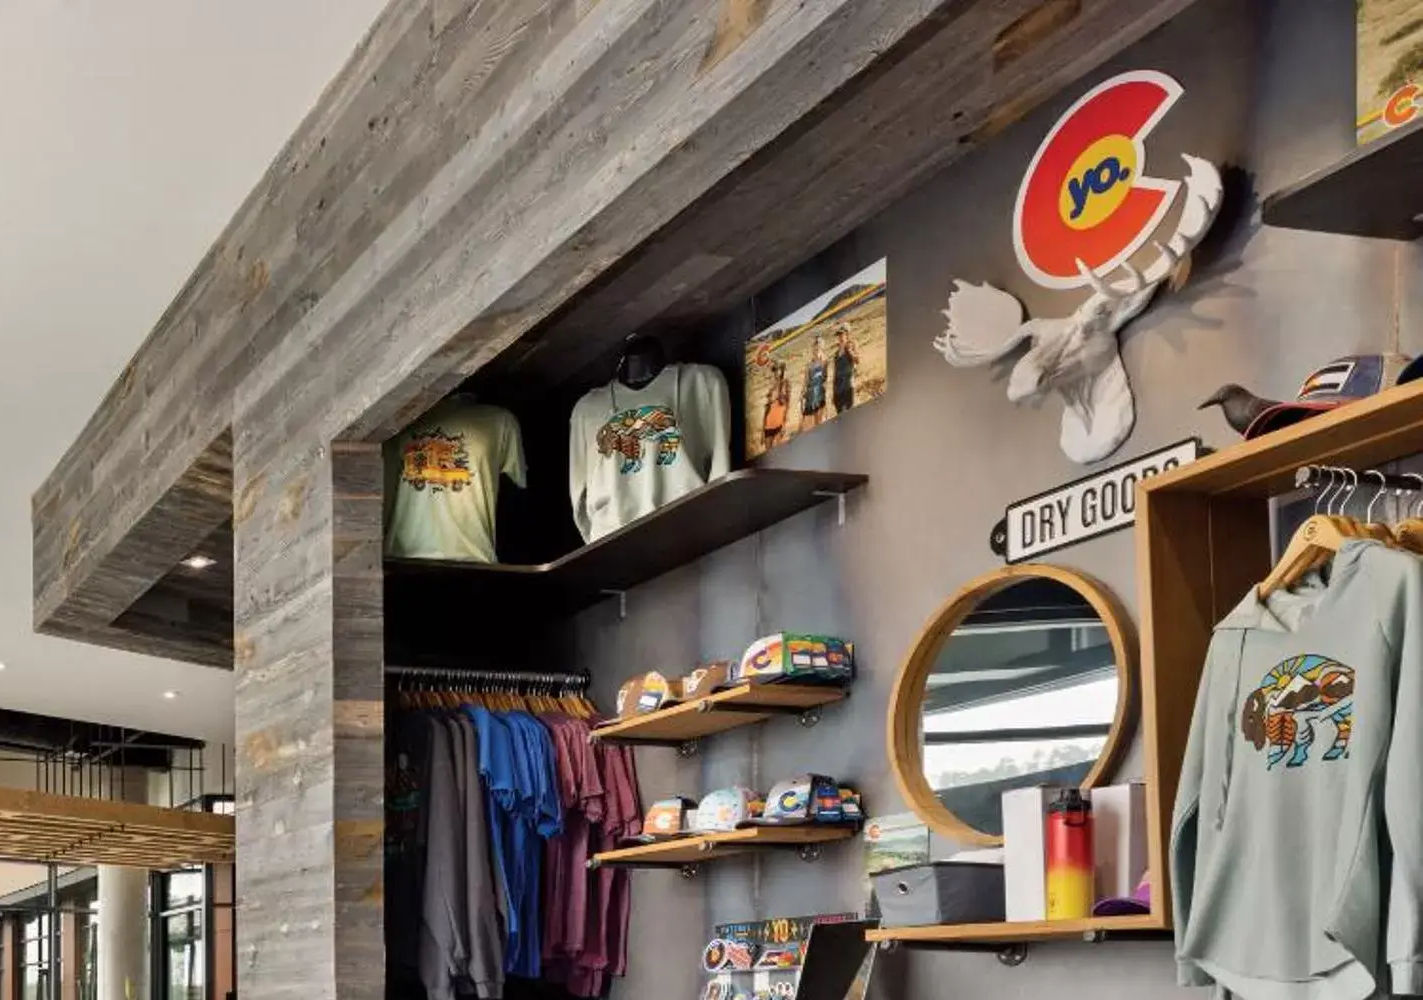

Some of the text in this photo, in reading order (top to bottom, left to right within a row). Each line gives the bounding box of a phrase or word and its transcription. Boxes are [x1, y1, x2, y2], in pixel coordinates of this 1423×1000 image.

[1068, 156, 1130, 220] yo.
[1021, 456, 1180, 549] DRY GOO
